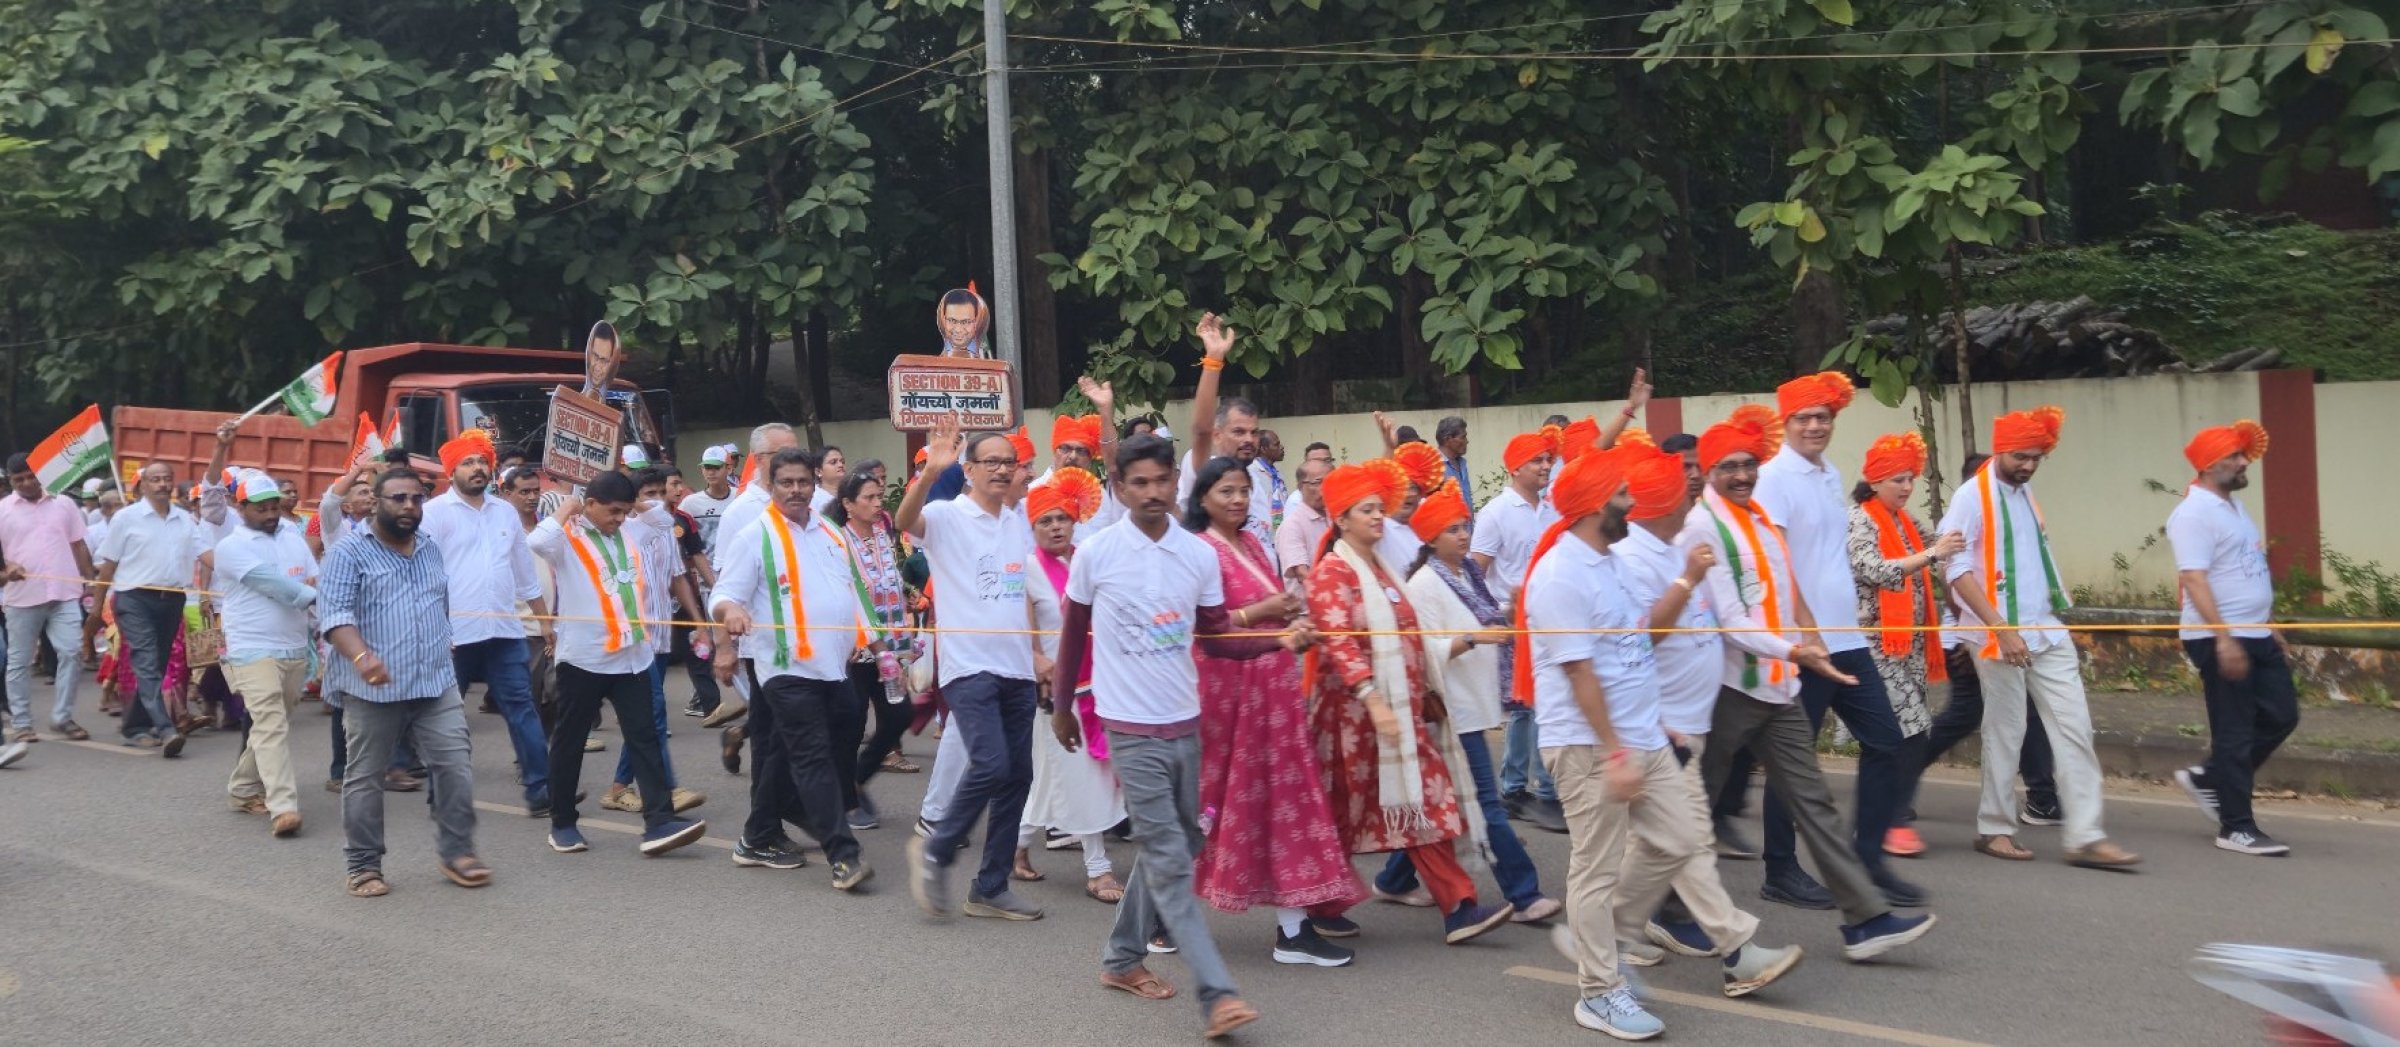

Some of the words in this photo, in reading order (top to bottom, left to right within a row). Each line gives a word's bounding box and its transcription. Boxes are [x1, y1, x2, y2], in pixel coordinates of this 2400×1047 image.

[902, 374, 961, 390] SECTION
[963, 375, 998, 391] 39-A
[556, 408, 589, 436] SECTION
[590, 422, 612, 442] 39-A
